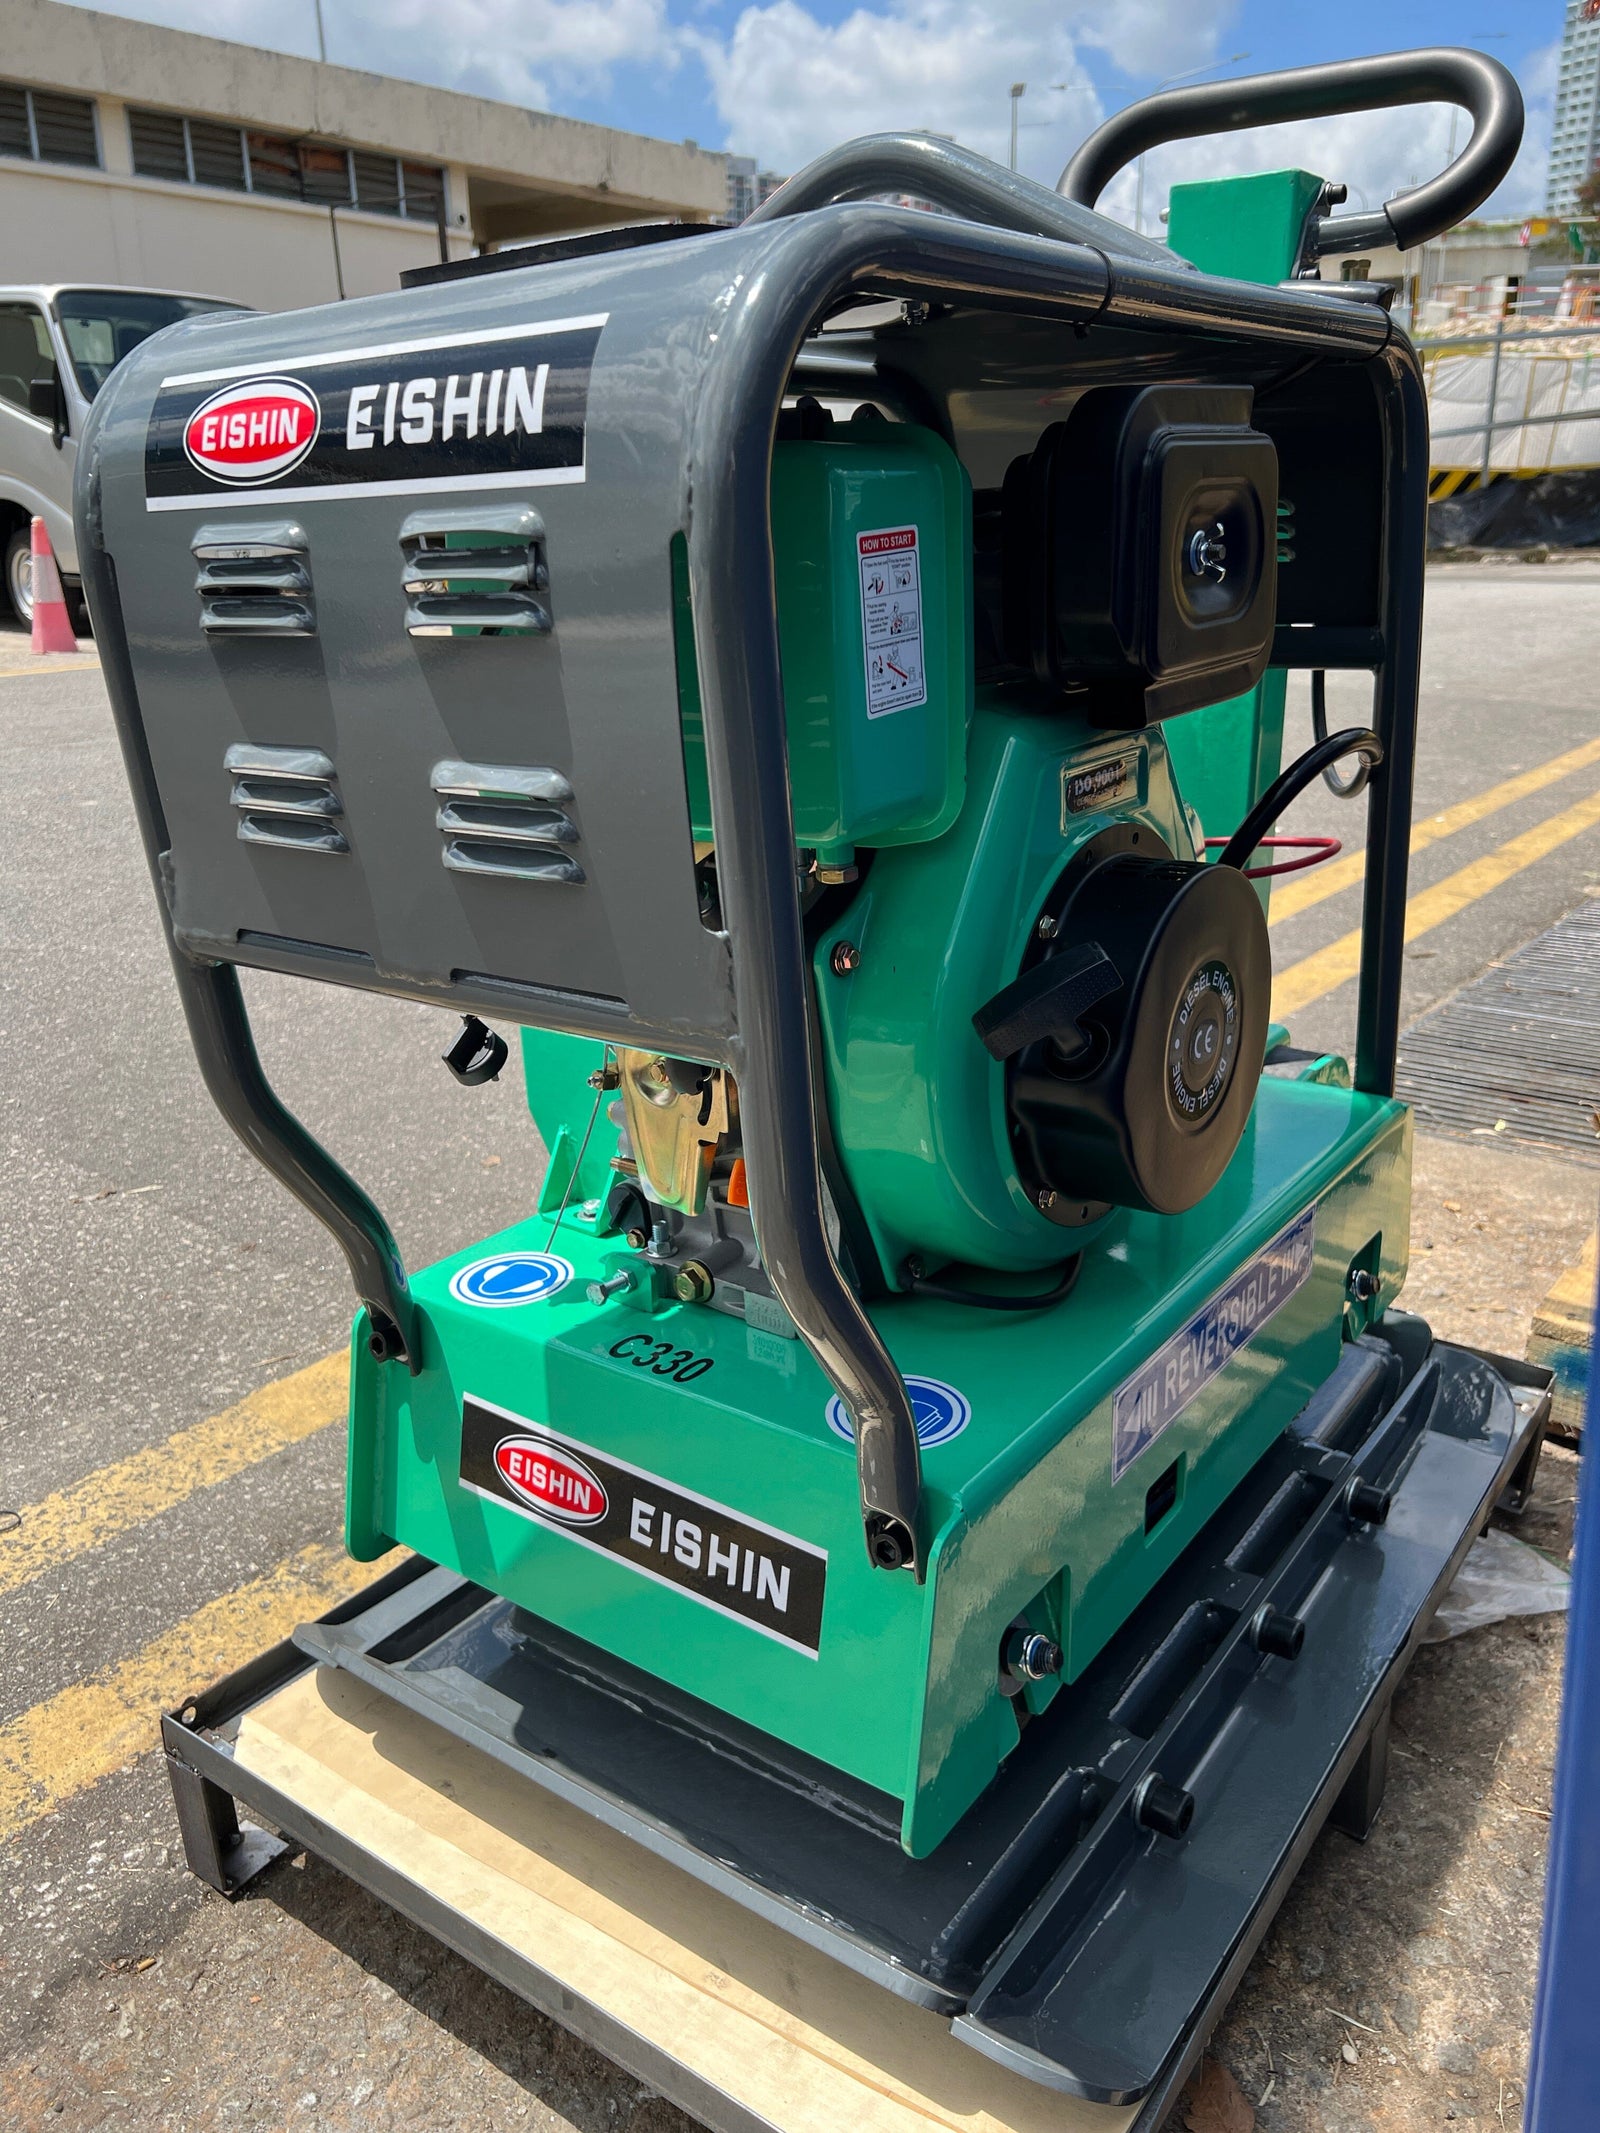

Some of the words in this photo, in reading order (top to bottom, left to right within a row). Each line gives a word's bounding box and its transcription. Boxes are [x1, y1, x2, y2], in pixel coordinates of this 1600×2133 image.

[201, 406, 301, 452] EISHIN
[346, 363, 549, 451] EISHIN
[862, 538, 879, 551] HOW
[880, 537, 889, 549] TO
[890, 534, 912, 547] START
[1179, 971, 1211, 1025] DIESEL
[1212, 970, 1235, 1023] ENGINE
[1194, 1024, 1213, 1059] CE
[1172, 1062, 1196, 1113] ENGINE
[1197, 1058, 1227, 1110] DIESEL
[608, 1334, 715, 1383] C330
[1164, 1266, 1277, 1409] REVERSIBLE
[508, 1450, 592, 1512] EISHIN
[629, 1497, 791, 1613] EISHIN
